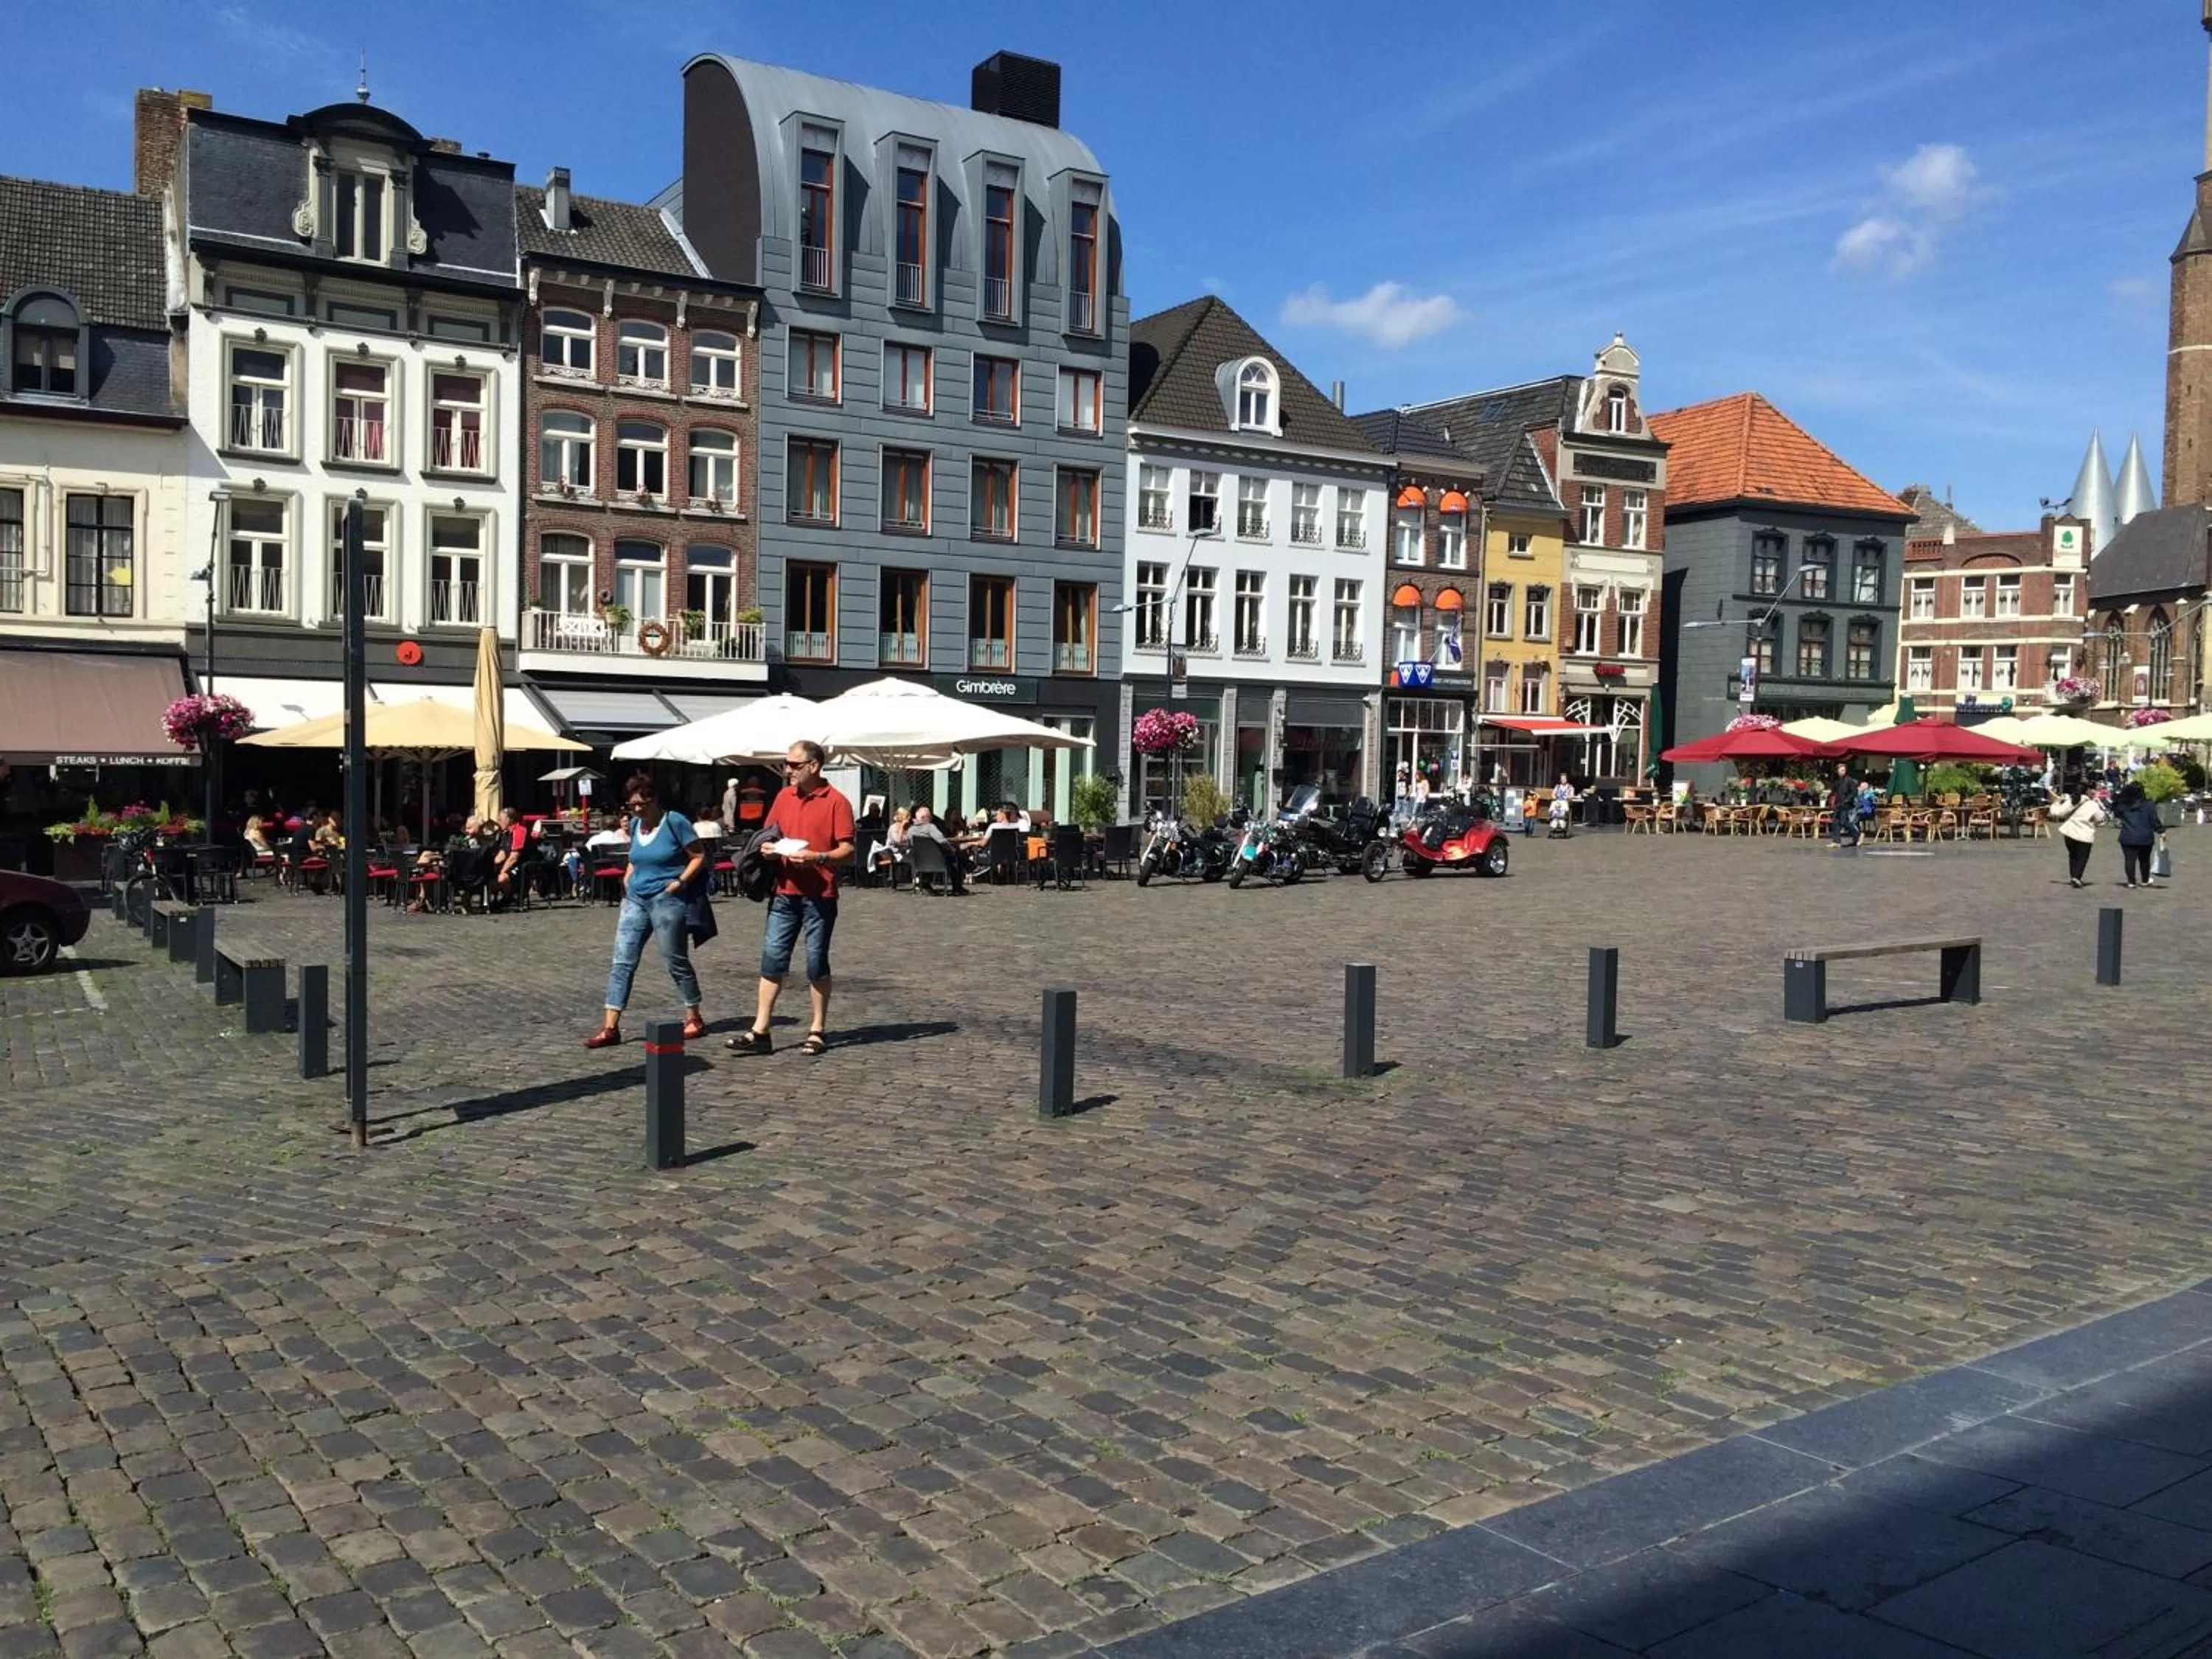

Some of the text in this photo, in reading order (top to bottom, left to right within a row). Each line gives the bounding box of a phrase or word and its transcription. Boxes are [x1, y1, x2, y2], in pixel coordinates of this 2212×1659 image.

[956, 679, 1017, 695] Gimbrère
[55, 756, 97, 765] STEAKS
[109, 757, 144, 765] LUNCH
